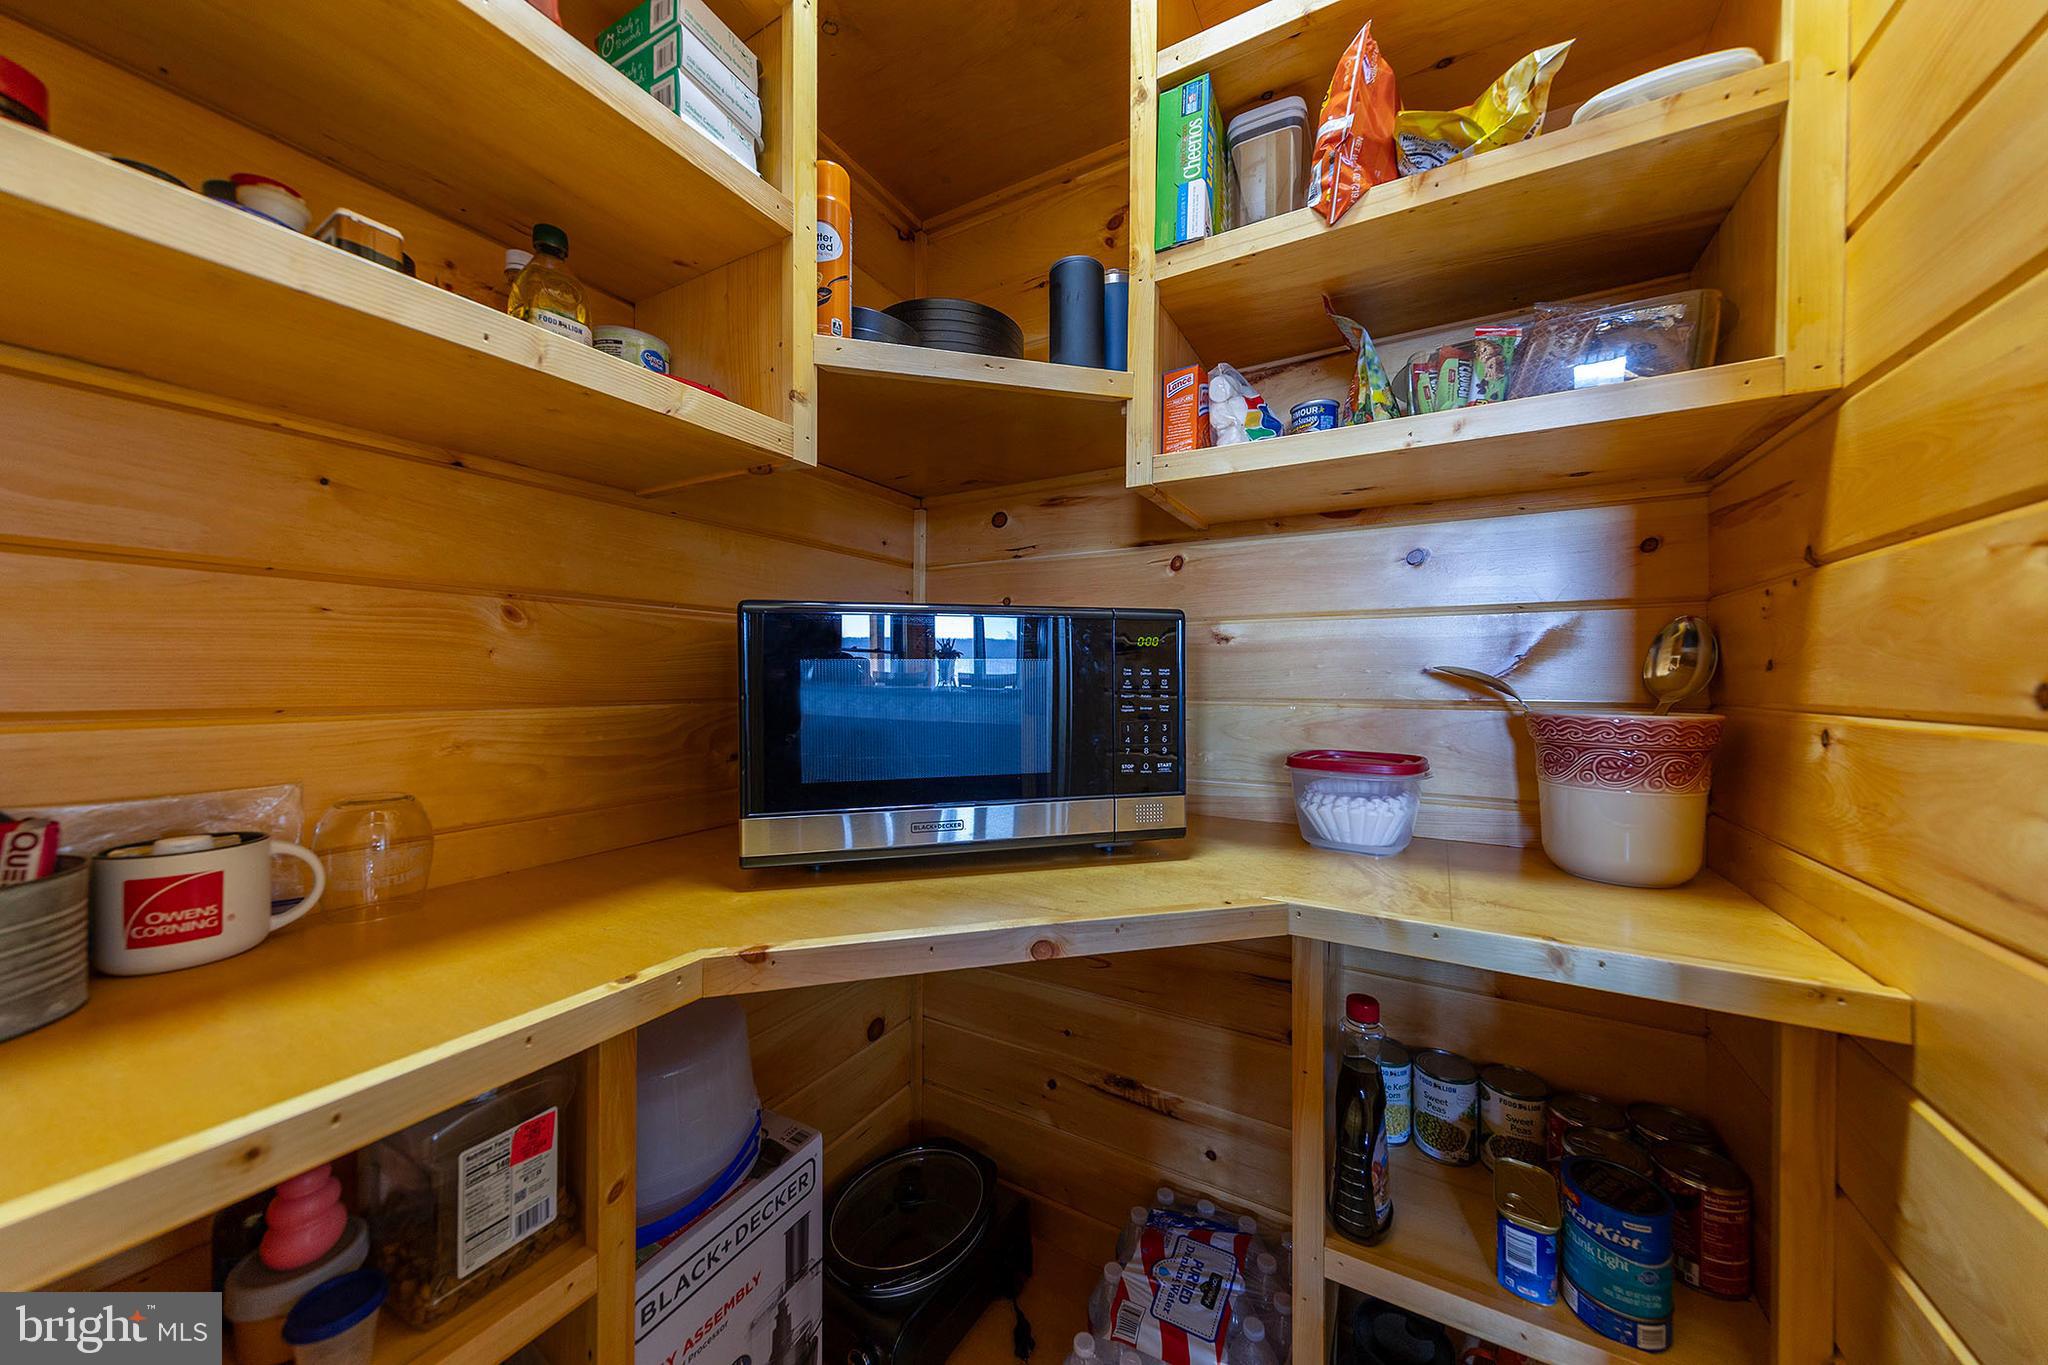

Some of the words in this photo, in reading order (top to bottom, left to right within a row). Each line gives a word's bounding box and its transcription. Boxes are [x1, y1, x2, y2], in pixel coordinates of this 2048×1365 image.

[1184, 117, 1203, 179] Cheerios
[817, 232, 833, 242] tter
[538, 313, 558, 326] FOOD
[568, 323, 584, 336] LION
[1168, 376, 1193, 393] Lance
[913, 822, 962, 831] BLACK+DECKER
[3, 832, 39, 881] QUE
[144, 904, 218, 924] OWENS
[130, 916, 218, 939] CORNING
[1423, 1090, 1449, 1106] Sweet
[1442, 1085, 1457, 1094] LION
[1427, 1101, 1447, 1115] Peas
[1505, 1113, 1535, 1126] Sweet
[1510, 1124, 1532, 1136] Peas
[1565, 1200, 1642, 1250] StarKist
[640, 1171, 808, 1328] BLACK+DECKER
[1596, 1248, 1630, 1272] Light
[1162, 1284, 1180, 1314] Water
[682, 1270, 762, 1356] ASSEMBLY
[688, 1322, 729, 1362] Processor
